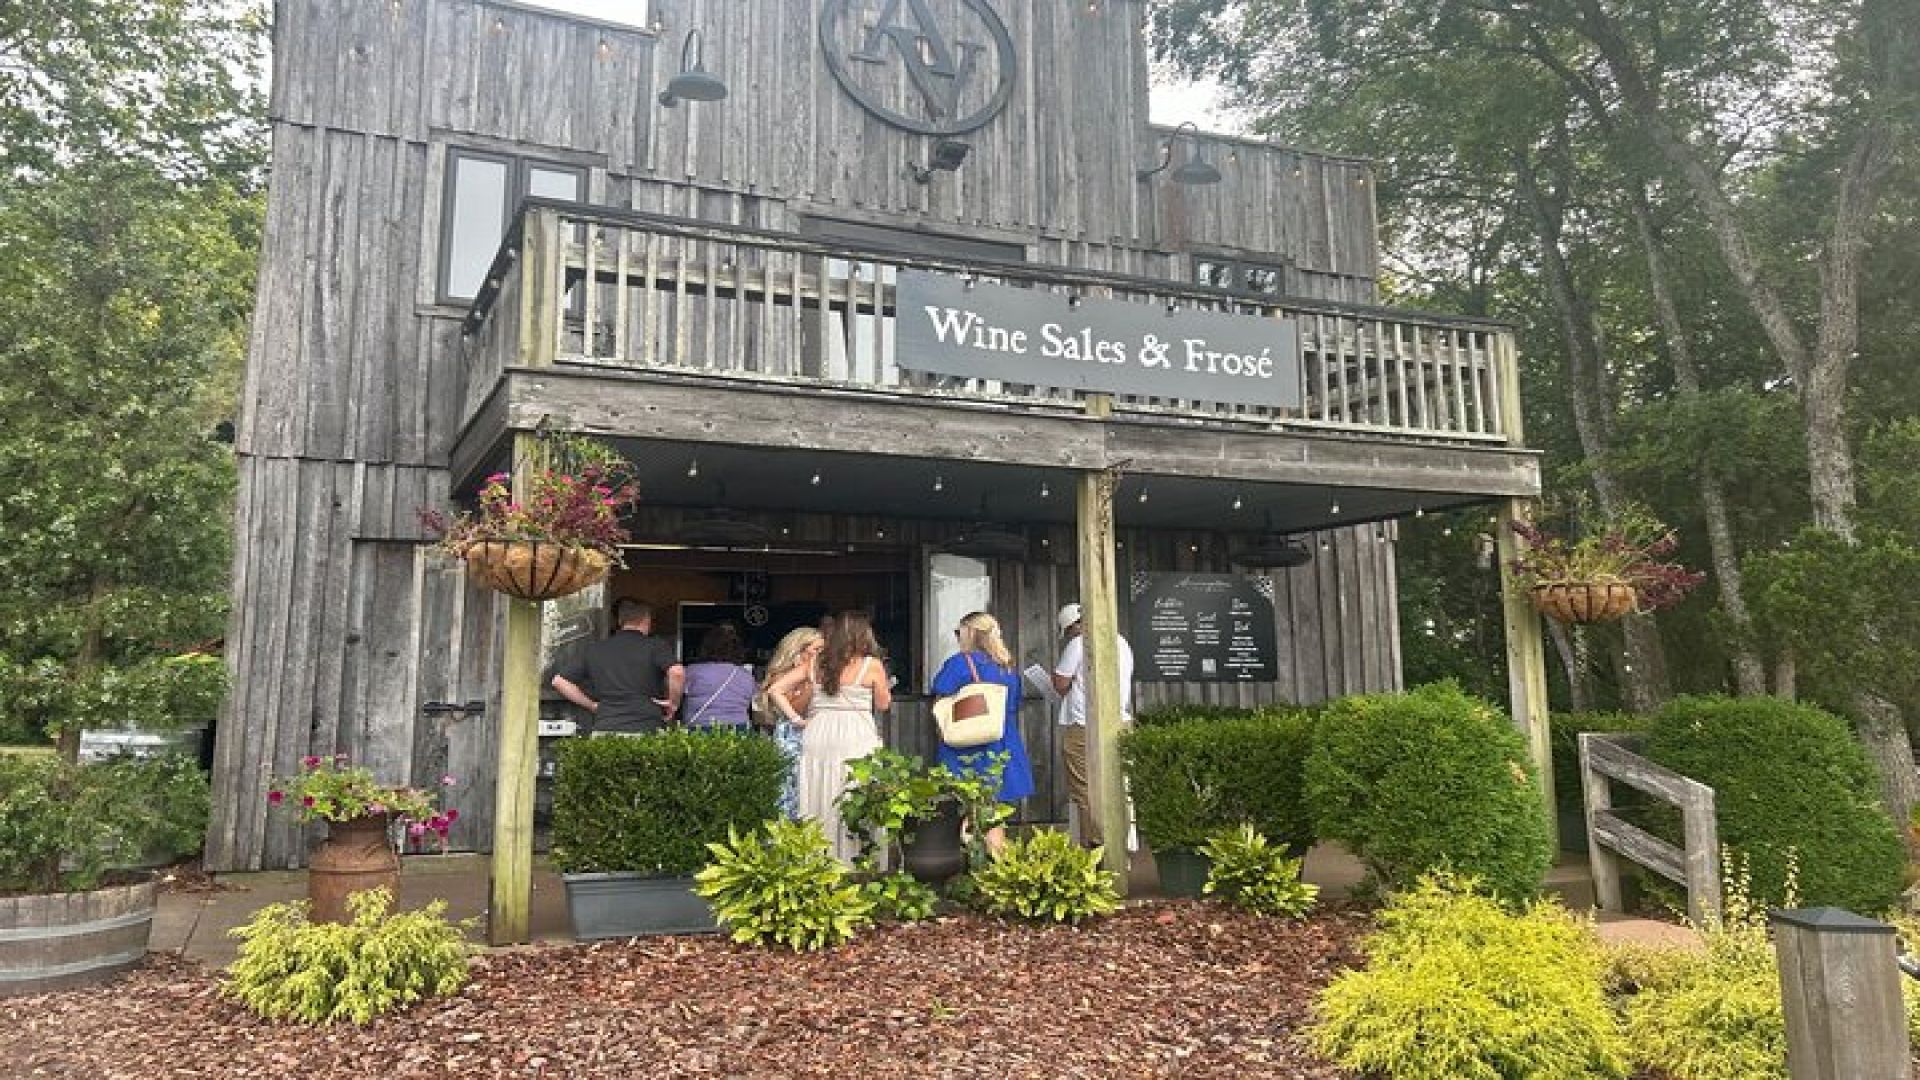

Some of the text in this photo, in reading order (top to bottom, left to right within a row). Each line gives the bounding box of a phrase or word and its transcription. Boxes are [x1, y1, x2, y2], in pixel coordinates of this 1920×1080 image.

[925, 306, 1272, 378] Wine Sales & Frosé
